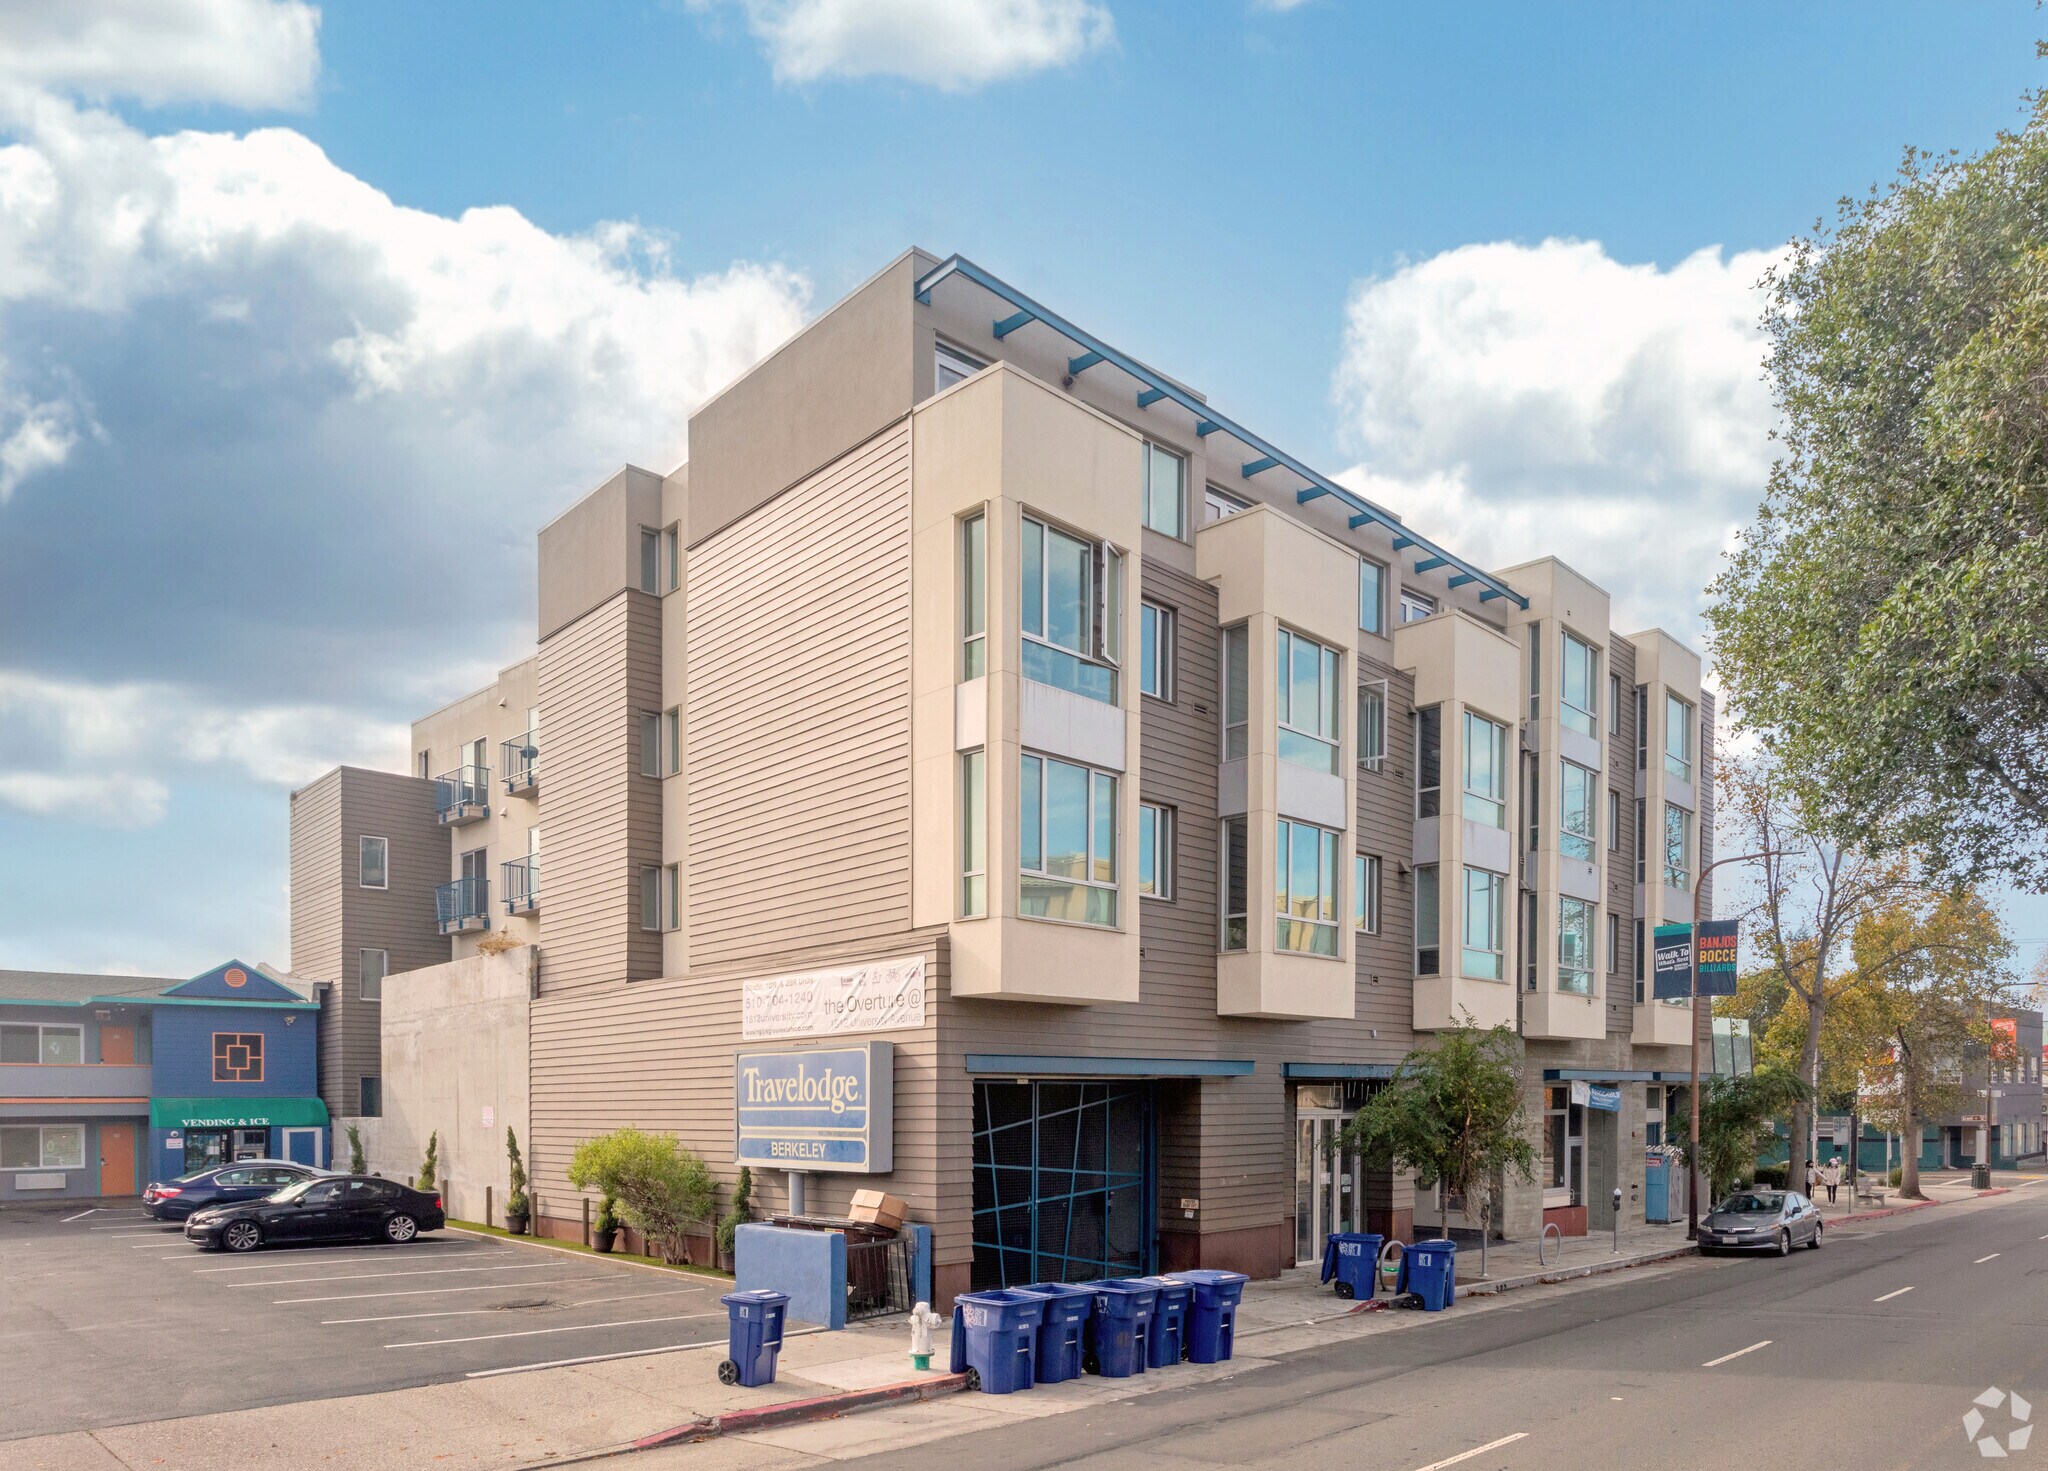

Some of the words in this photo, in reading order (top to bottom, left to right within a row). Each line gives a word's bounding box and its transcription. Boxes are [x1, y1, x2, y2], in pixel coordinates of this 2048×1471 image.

[1699, 935, 1737, 949] BANJOS
[1657, 950, 1679, 960] Walk
[1680, 948, 1689, 956] To
[1699, 949, 1736, 963] BOCCE
[1699, 963, 1736, 973] BILLIARDS
[823, 998, 844, 1015] the
[908, 988, 921, 1009] @
[743, 1064, 858, 1114] Travelodge
[182, 1118, 235, 1127] VENDING
[238, 1118, 247, 1126] &
[771, 1141, 826, 1159] BERKELEY
